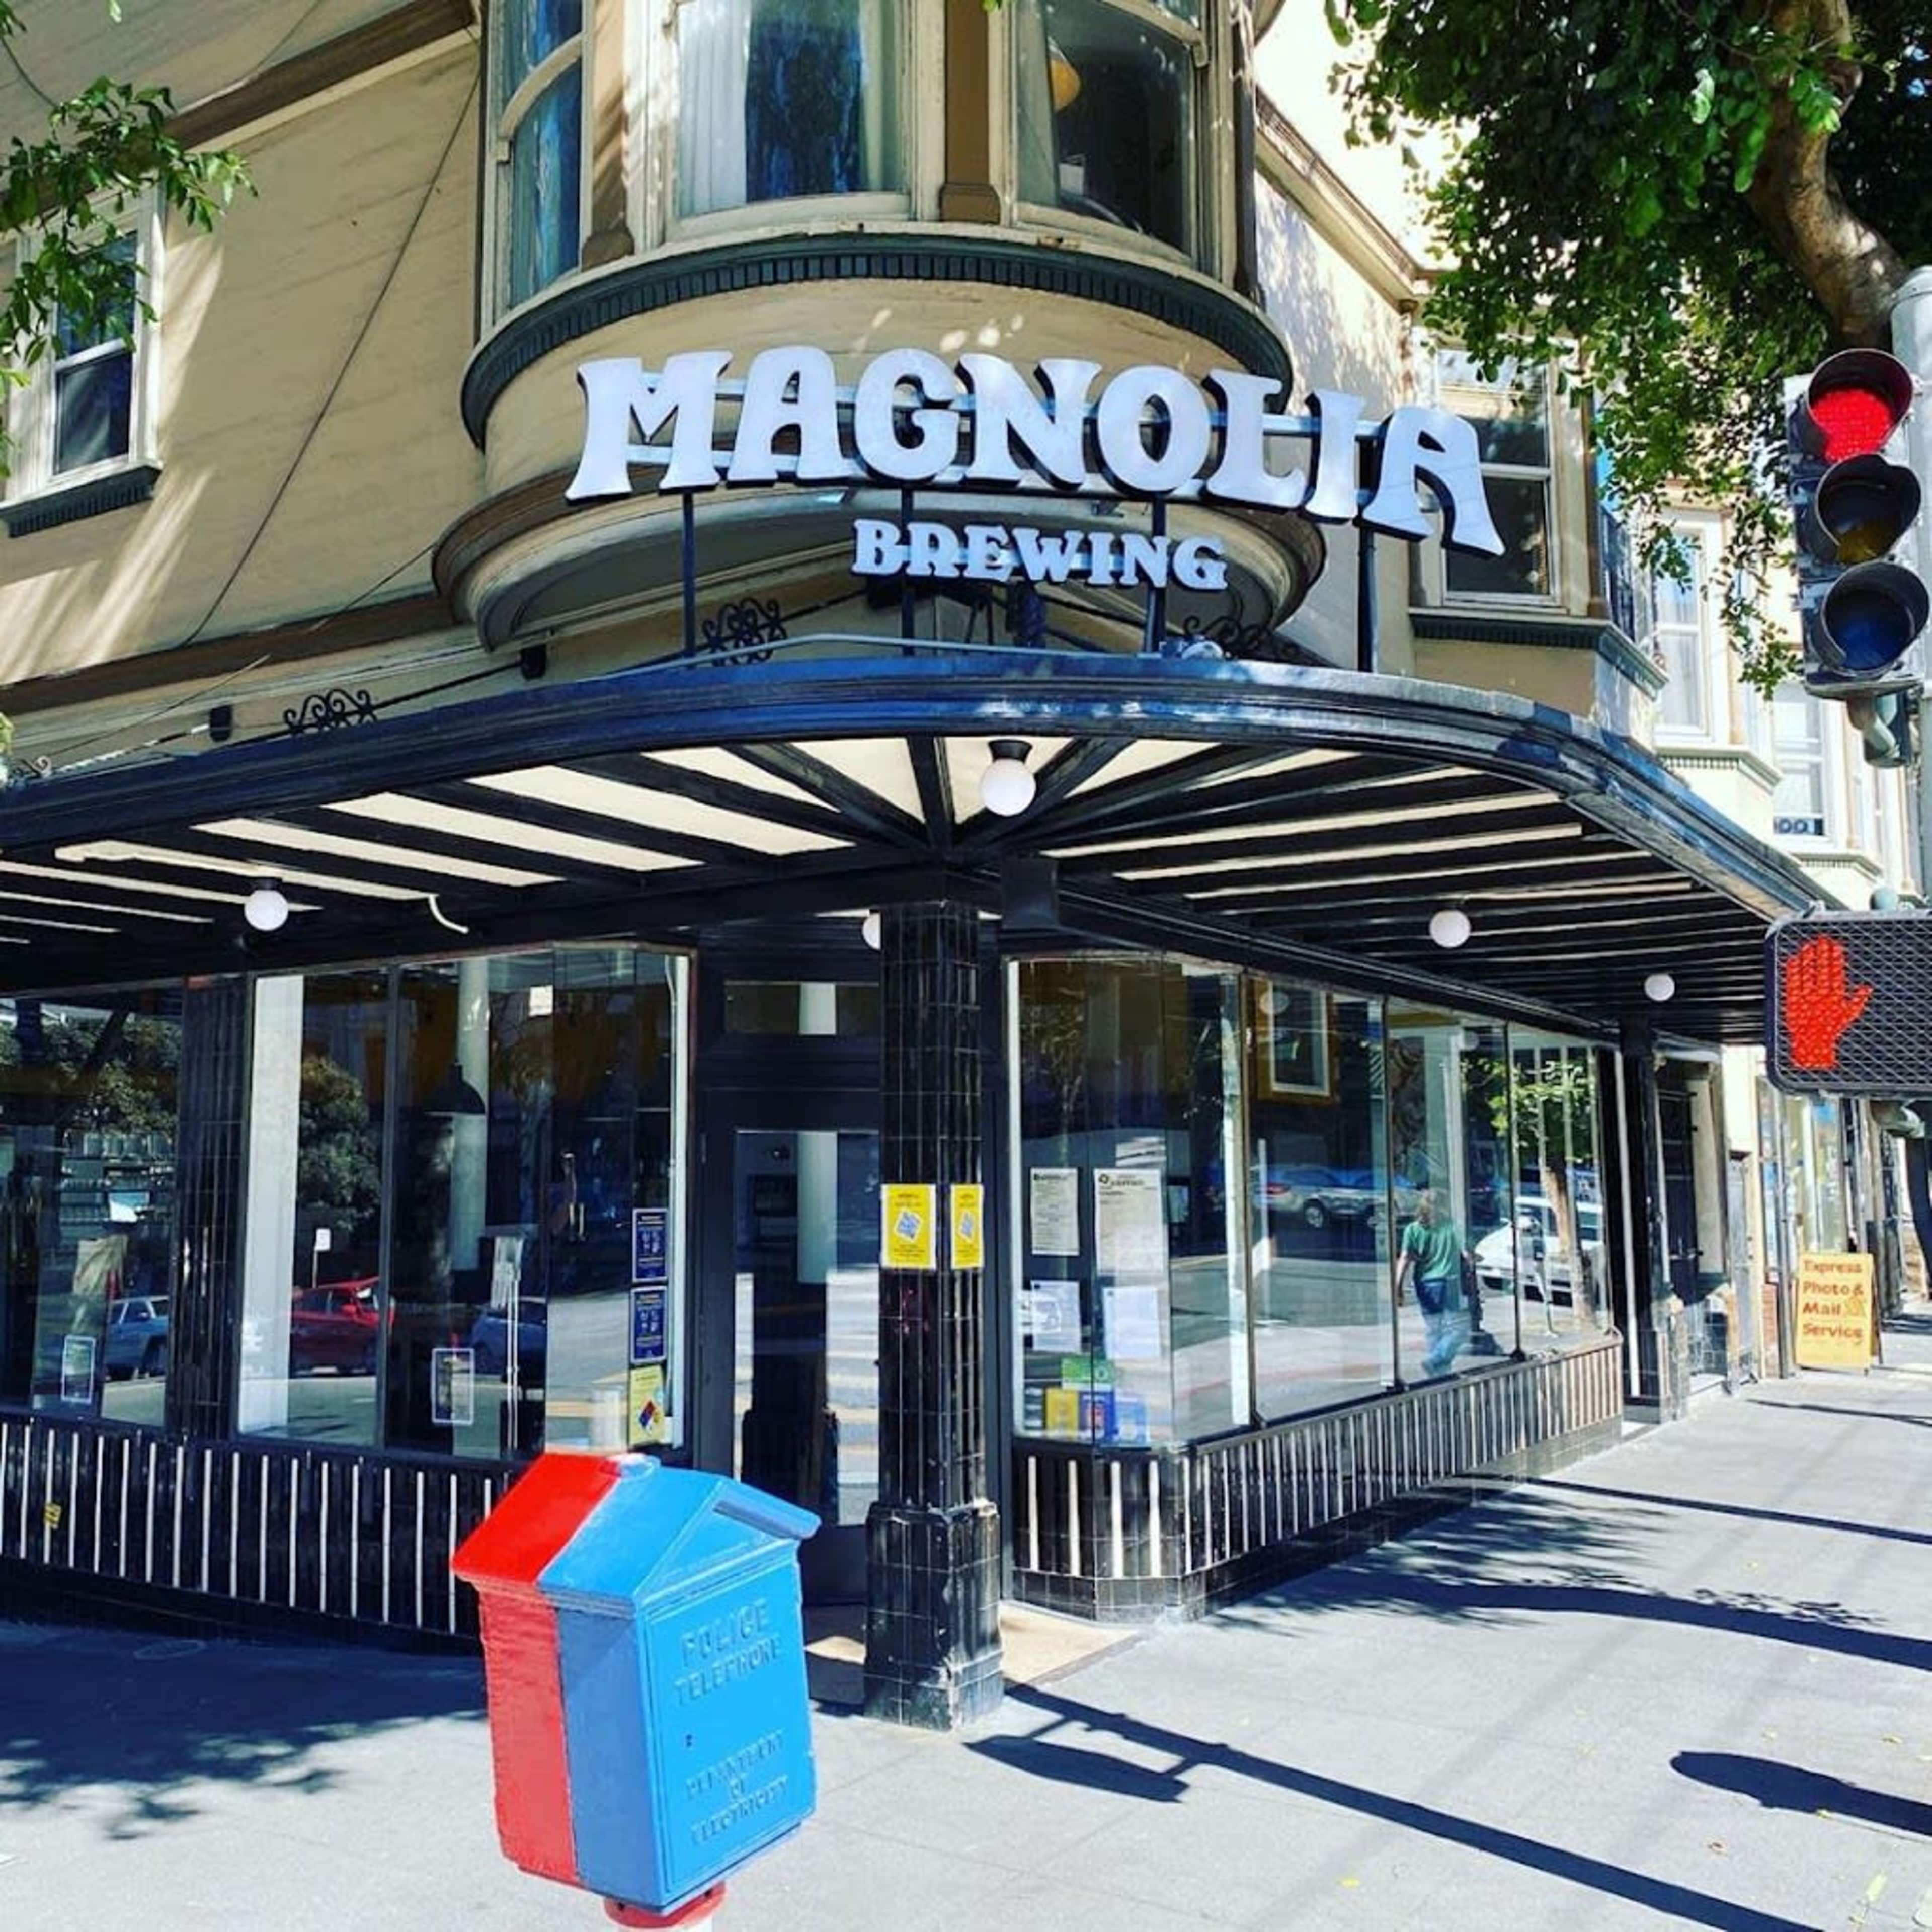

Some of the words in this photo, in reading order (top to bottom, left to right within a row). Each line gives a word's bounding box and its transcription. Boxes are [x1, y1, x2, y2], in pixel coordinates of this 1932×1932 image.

[565, 346, 1506, 556] MAGNOLIA
[851, 519, 1228, 591] BREWING
[1803, 1259, 1862, 1275] Express
[1803, 1281, 1850, 1296] Photo
[1802, 1301, 1841, 1316] Mail
[1803, 1322, 1864, 1339] Service
[682, 1599, 767, 1668] POLICE
[675, 1634, 779, 1705] TELEPHONE
